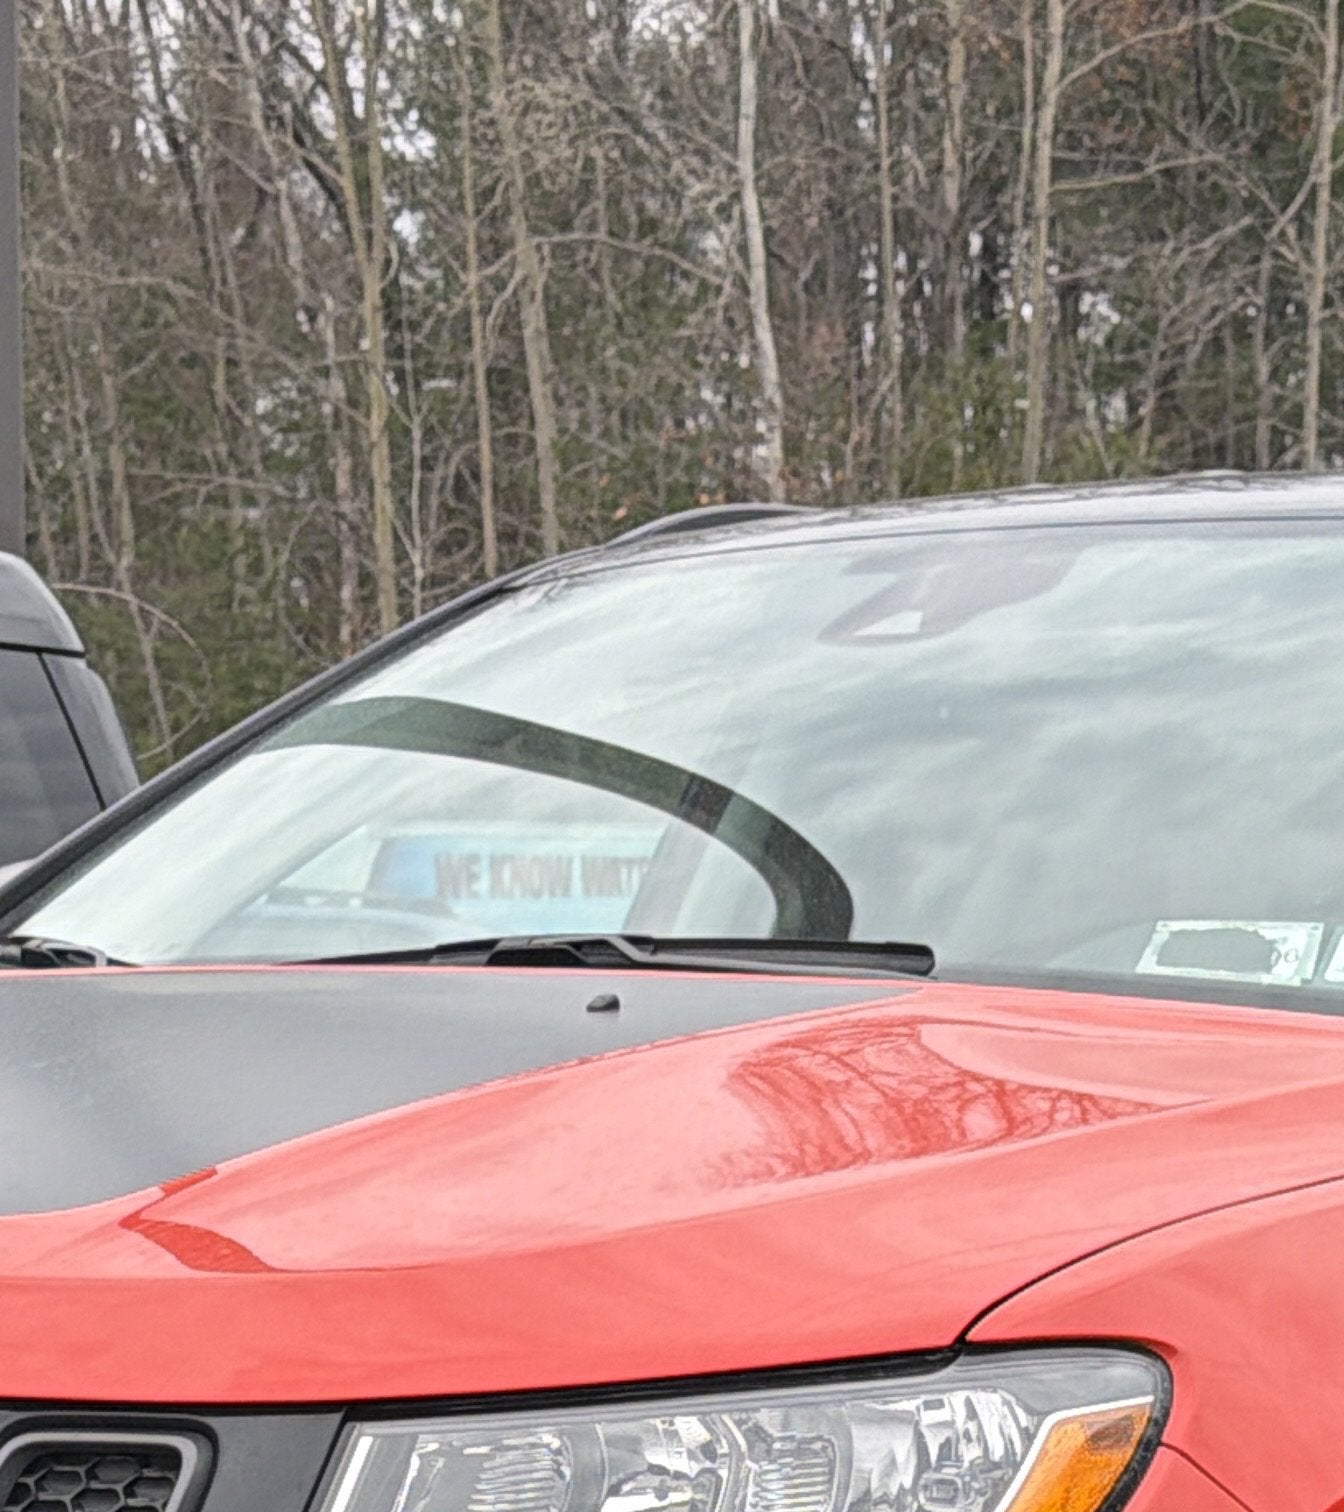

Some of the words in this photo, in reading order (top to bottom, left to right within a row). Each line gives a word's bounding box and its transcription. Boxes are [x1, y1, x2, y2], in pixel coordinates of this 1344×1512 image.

[434, 852, 481, 899] WE
[489, 852, 574, 899] KNOW
[581, 855, 650, 898] WAT
